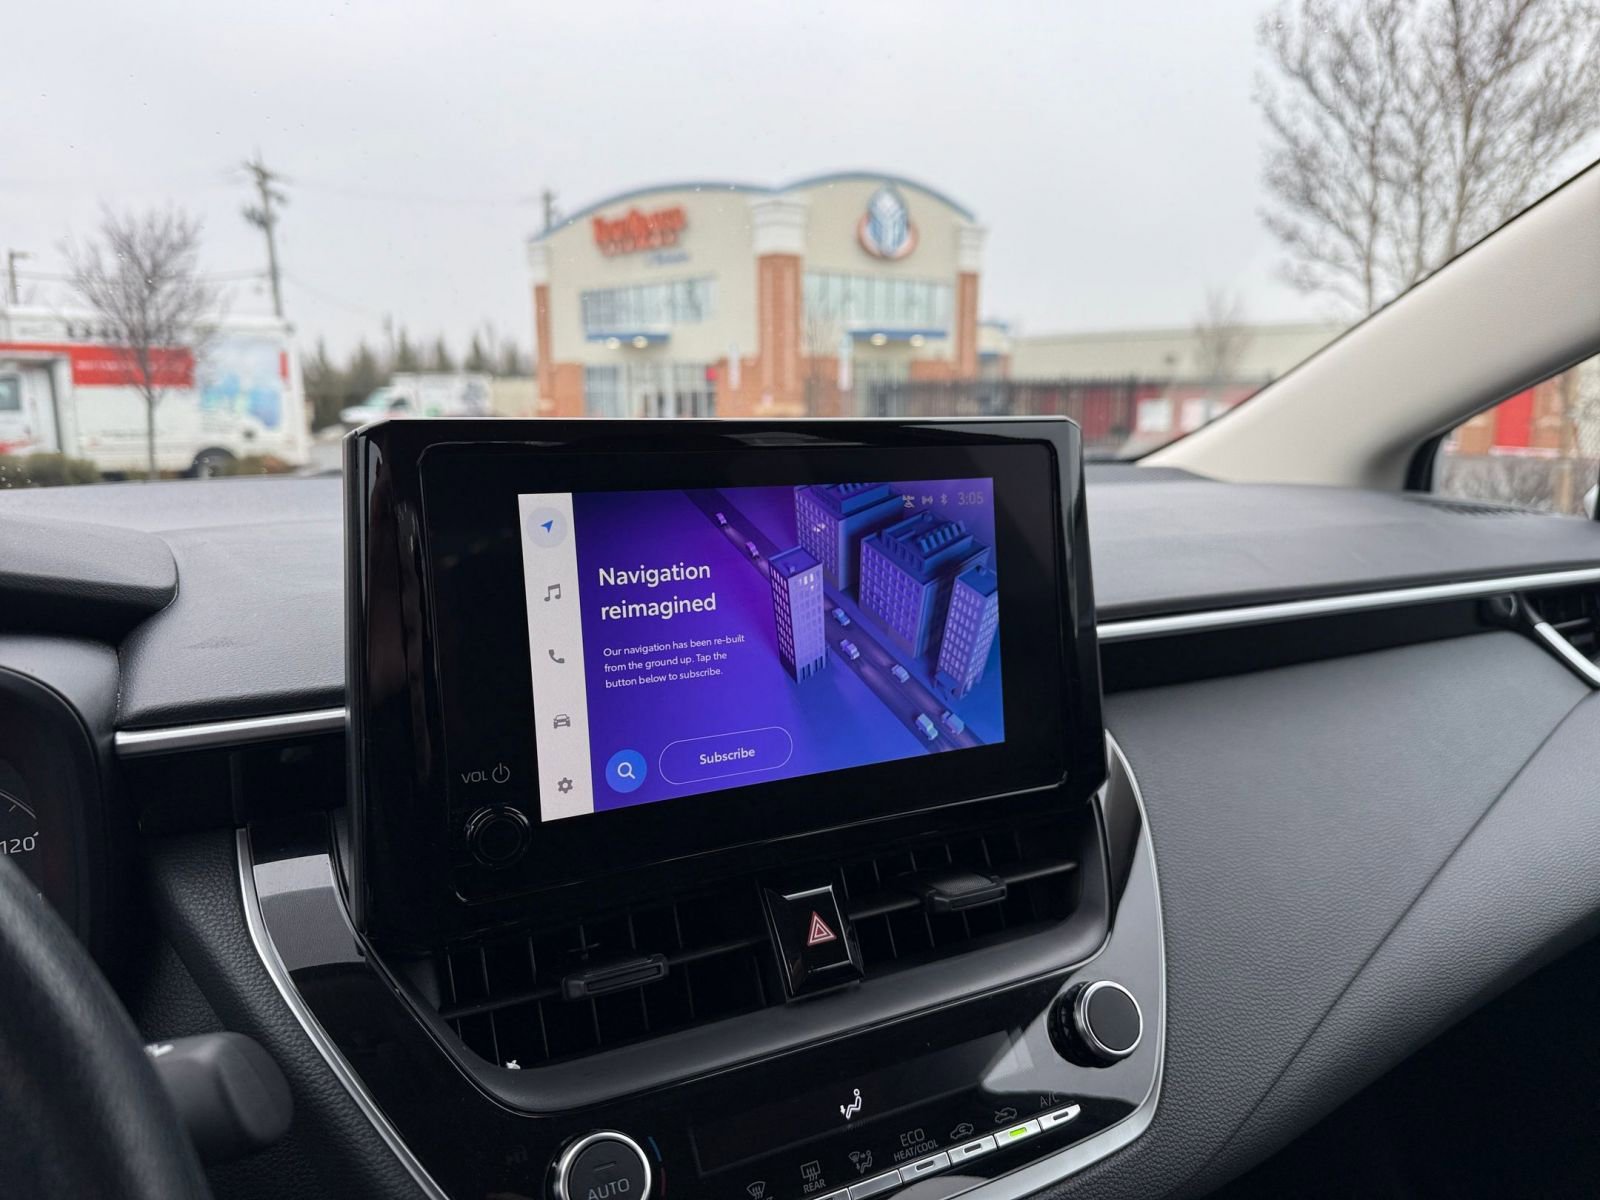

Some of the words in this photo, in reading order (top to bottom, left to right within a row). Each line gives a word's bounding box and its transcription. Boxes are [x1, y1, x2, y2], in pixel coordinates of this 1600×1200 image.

[957, 491, 984, 505] 3:05
[598, 562, 711, 587] Navigation
[601, 592, 717, 619] reimagined
[603, 647, 622, 657] Our
[623, 641, 671, 655] navigation
[672, 640, 688, 650] has
[690, 637, 712, 648] been
[713, 634, 745, 645] re-built
[604, 662, 627, 673] from
[628, 660, 643, 670] the
[645, 656, 678, 670] ground
[680, 657, 695, 667] up.
[696, 653, 712, 664] Tap
[713, 651, 728, 661] the
[605, 677, 638, 689] button
[638, 674, 667, 685] below
[668, 672, 678, 681] to
[679, 666, 723, 680] subscribe.
[699, 747, 756, 765] Subscribe
[461, 771, 488, 784] VOL
[0, 836, 36, 854] 120
[1040, 1091, 1060, 1108] A/C
[900, 1127, 926, 1147] ECO
[893, 1139, 939, 1162] HEAT/COOL
[587, 1178, 630, 1200] AUTO
[803, 1178, 826, 1194] REAR
